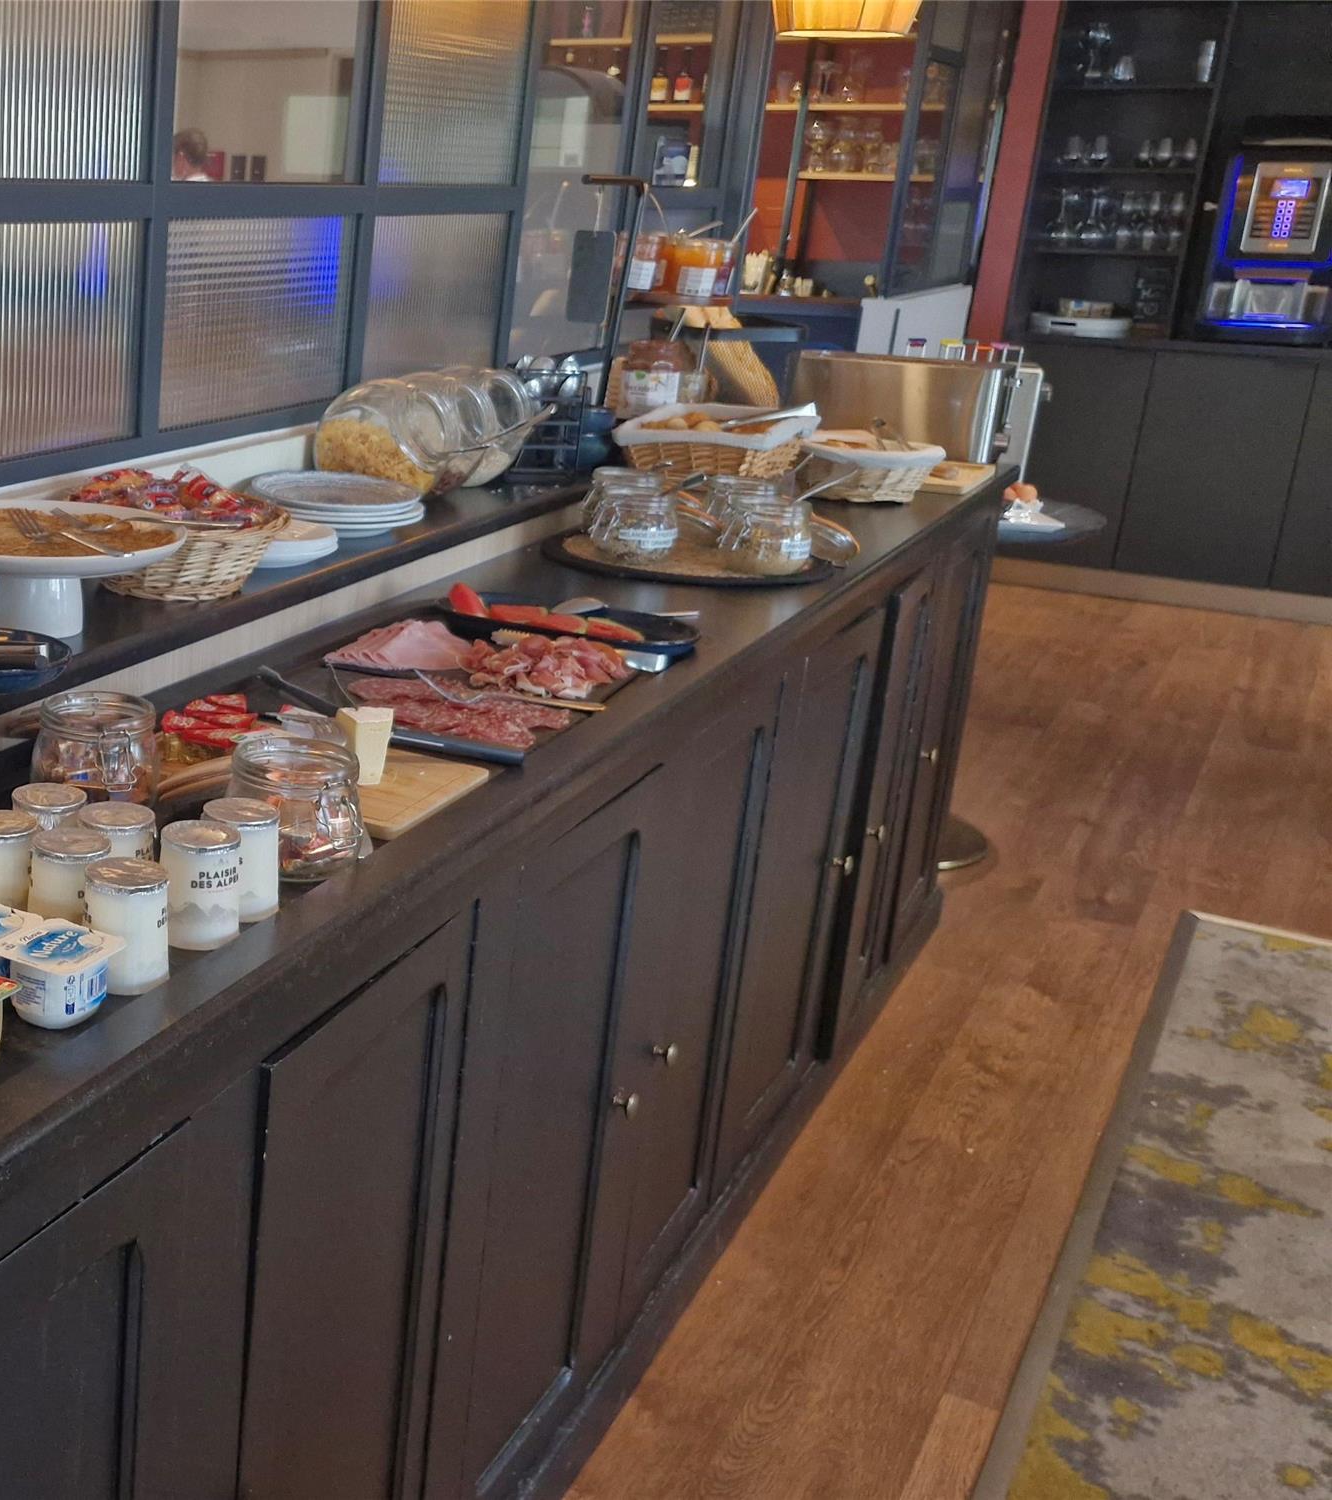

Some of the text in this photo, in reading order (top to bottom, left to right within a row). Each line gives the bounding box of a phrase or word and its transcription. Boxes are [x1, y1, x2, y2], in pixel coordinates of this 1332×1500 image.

[199, 867, 236, 880] PLAISIR
[191, 881, 212, 889] DES
[29, 930, 78, 957] Nature
